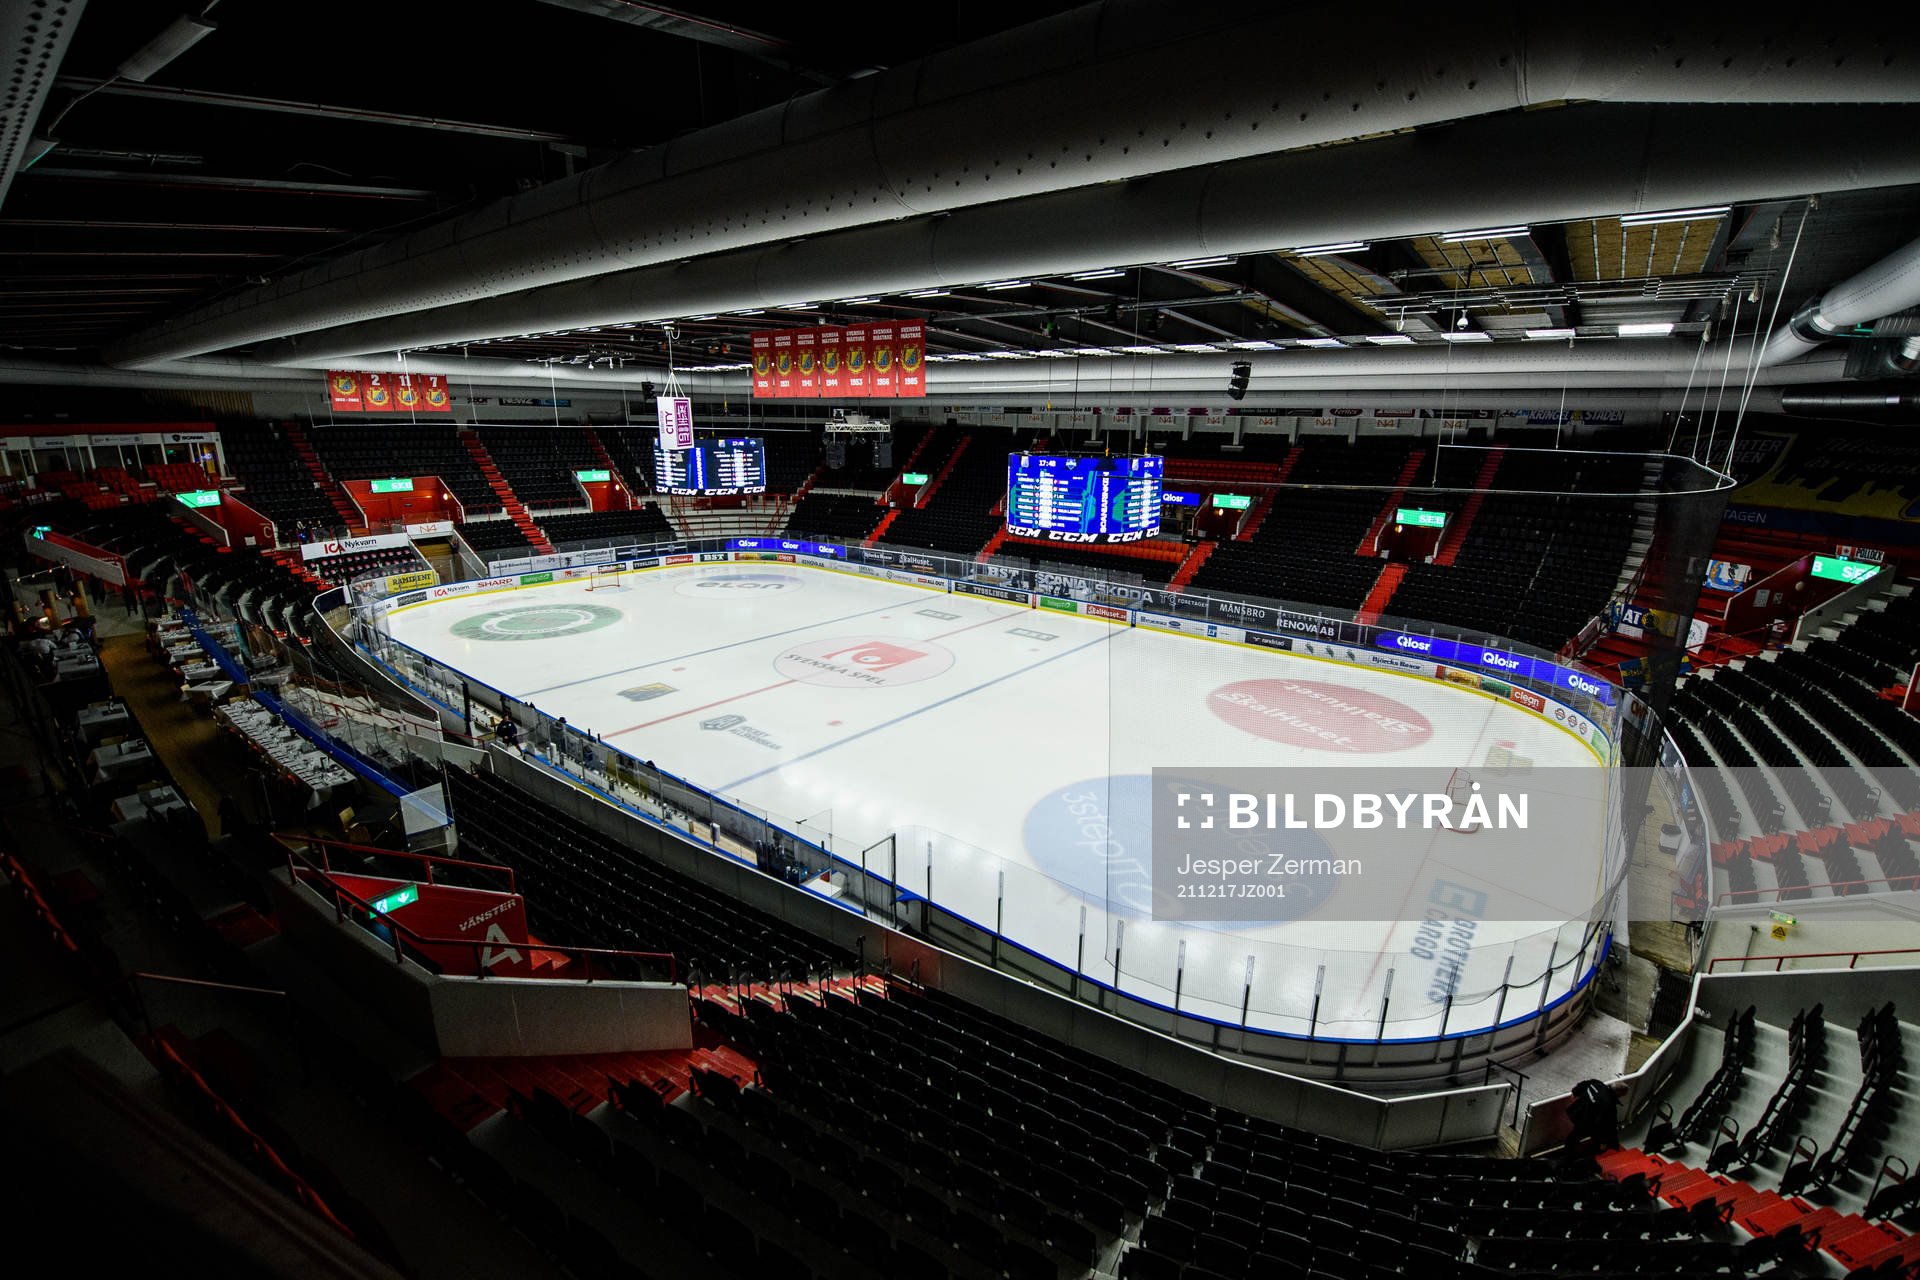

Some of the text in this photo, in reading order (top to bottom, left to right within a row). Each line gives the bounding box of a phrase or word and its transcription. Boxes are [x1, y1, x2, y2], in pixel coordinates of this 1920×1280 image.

[371, 375, 380, 385] 2
[430, 377, 438, 387] 7
[665, 411, 674, 434] CITY
[1315, 418, 1332, 426] N4
[1377, 419, 1394, 427] N4
[1443, 420, 1463, 428] N4
[671, 487, 698, 496] CCM
[704, 487, 738, 496] CCM
[1008, 525, 1041, 538] CCM
[1049, 530, 1098, 543] CCM
[1107, 530, 1144, 543] CCM
[324, 537, 377, 555] ICA Nykvarn
[393, 574, 431, 586] RAMIRENT
[477, 578, 513, 589] SHARP
[1035, 573, 1087, 591] SCANIA
[434, 585, 469, 598] ICA Nykvarn
[1219, 603, 1266, 619] MÅNSBRO
[1276, 618, 1335, 637] RENOVA AB
[1397, 635, 1430, 651] Qlosr
[1483, 651, 1519, 669] Qlosr
[784, 653, 888, 686] SVENSKA SPEL
[1568, 674, 1600, 696] Qlosr
[1514, 690, 1540, 707] clean
[459, 898, 517, 932] VÄNSTER
[1410, 907, 1449, 961] CARGO
[481, 922, 524, 969] A
